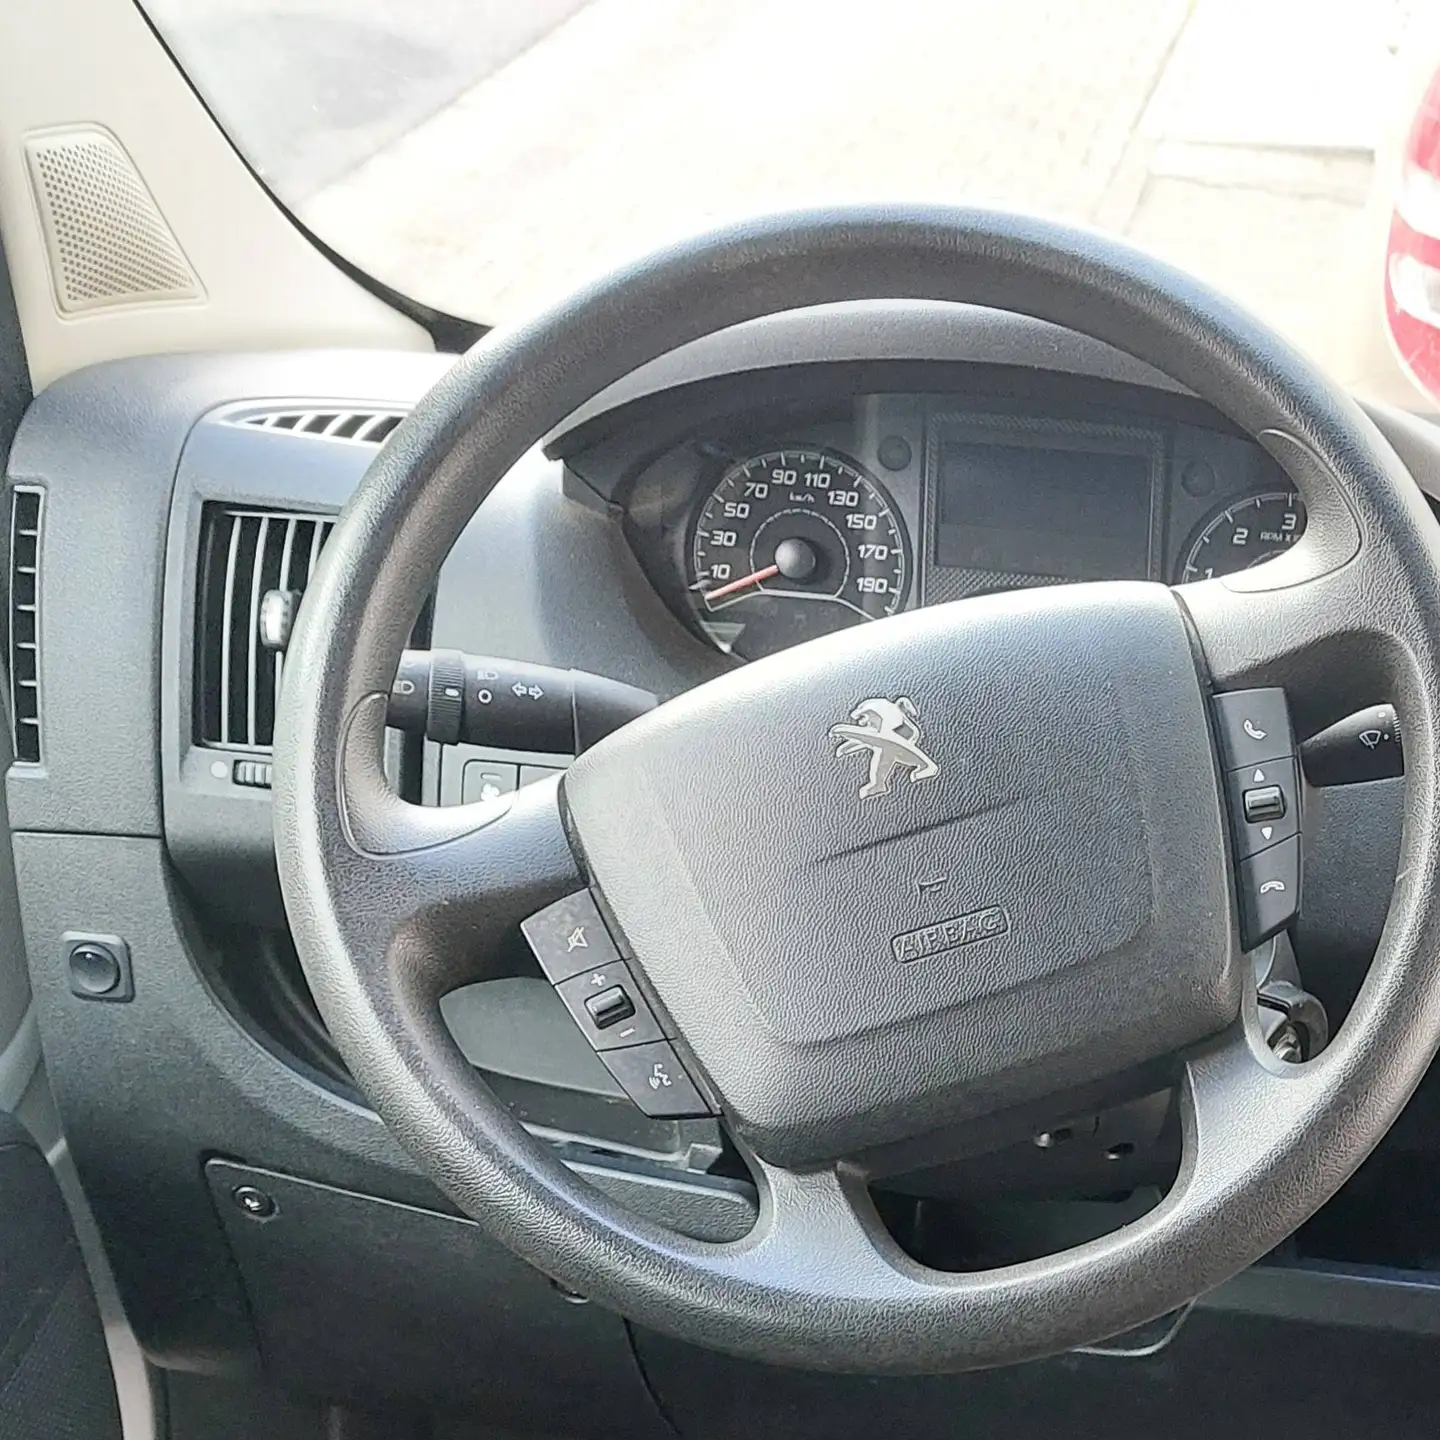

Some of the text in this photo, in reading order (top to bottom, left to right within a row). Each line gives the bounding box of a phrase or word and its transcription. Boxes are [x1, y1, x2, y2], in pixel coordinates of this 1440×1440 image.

[771, 469, 797, 485] 90
[803, 473, 831, 489] 110
[744, 482, 769, 499] 70
[789, 492, 815, 503] km/h
[827, 491, 859, 507] 130
[723, 503, 750, 519] 50
[845, 513, 877, 530] 150
[1281, 513, 1297, 531] 3
[710, 530, 736, 546] 30
[1232, 527, 1249, 545] 2
[857, 544, 888, 560] 170
[711, 564, 731, 579] 10
[1204, 567, 1214, 580] 1
[856, 577, 888, 593] 190
[900, 911, 1001, 960] AIRBAG
